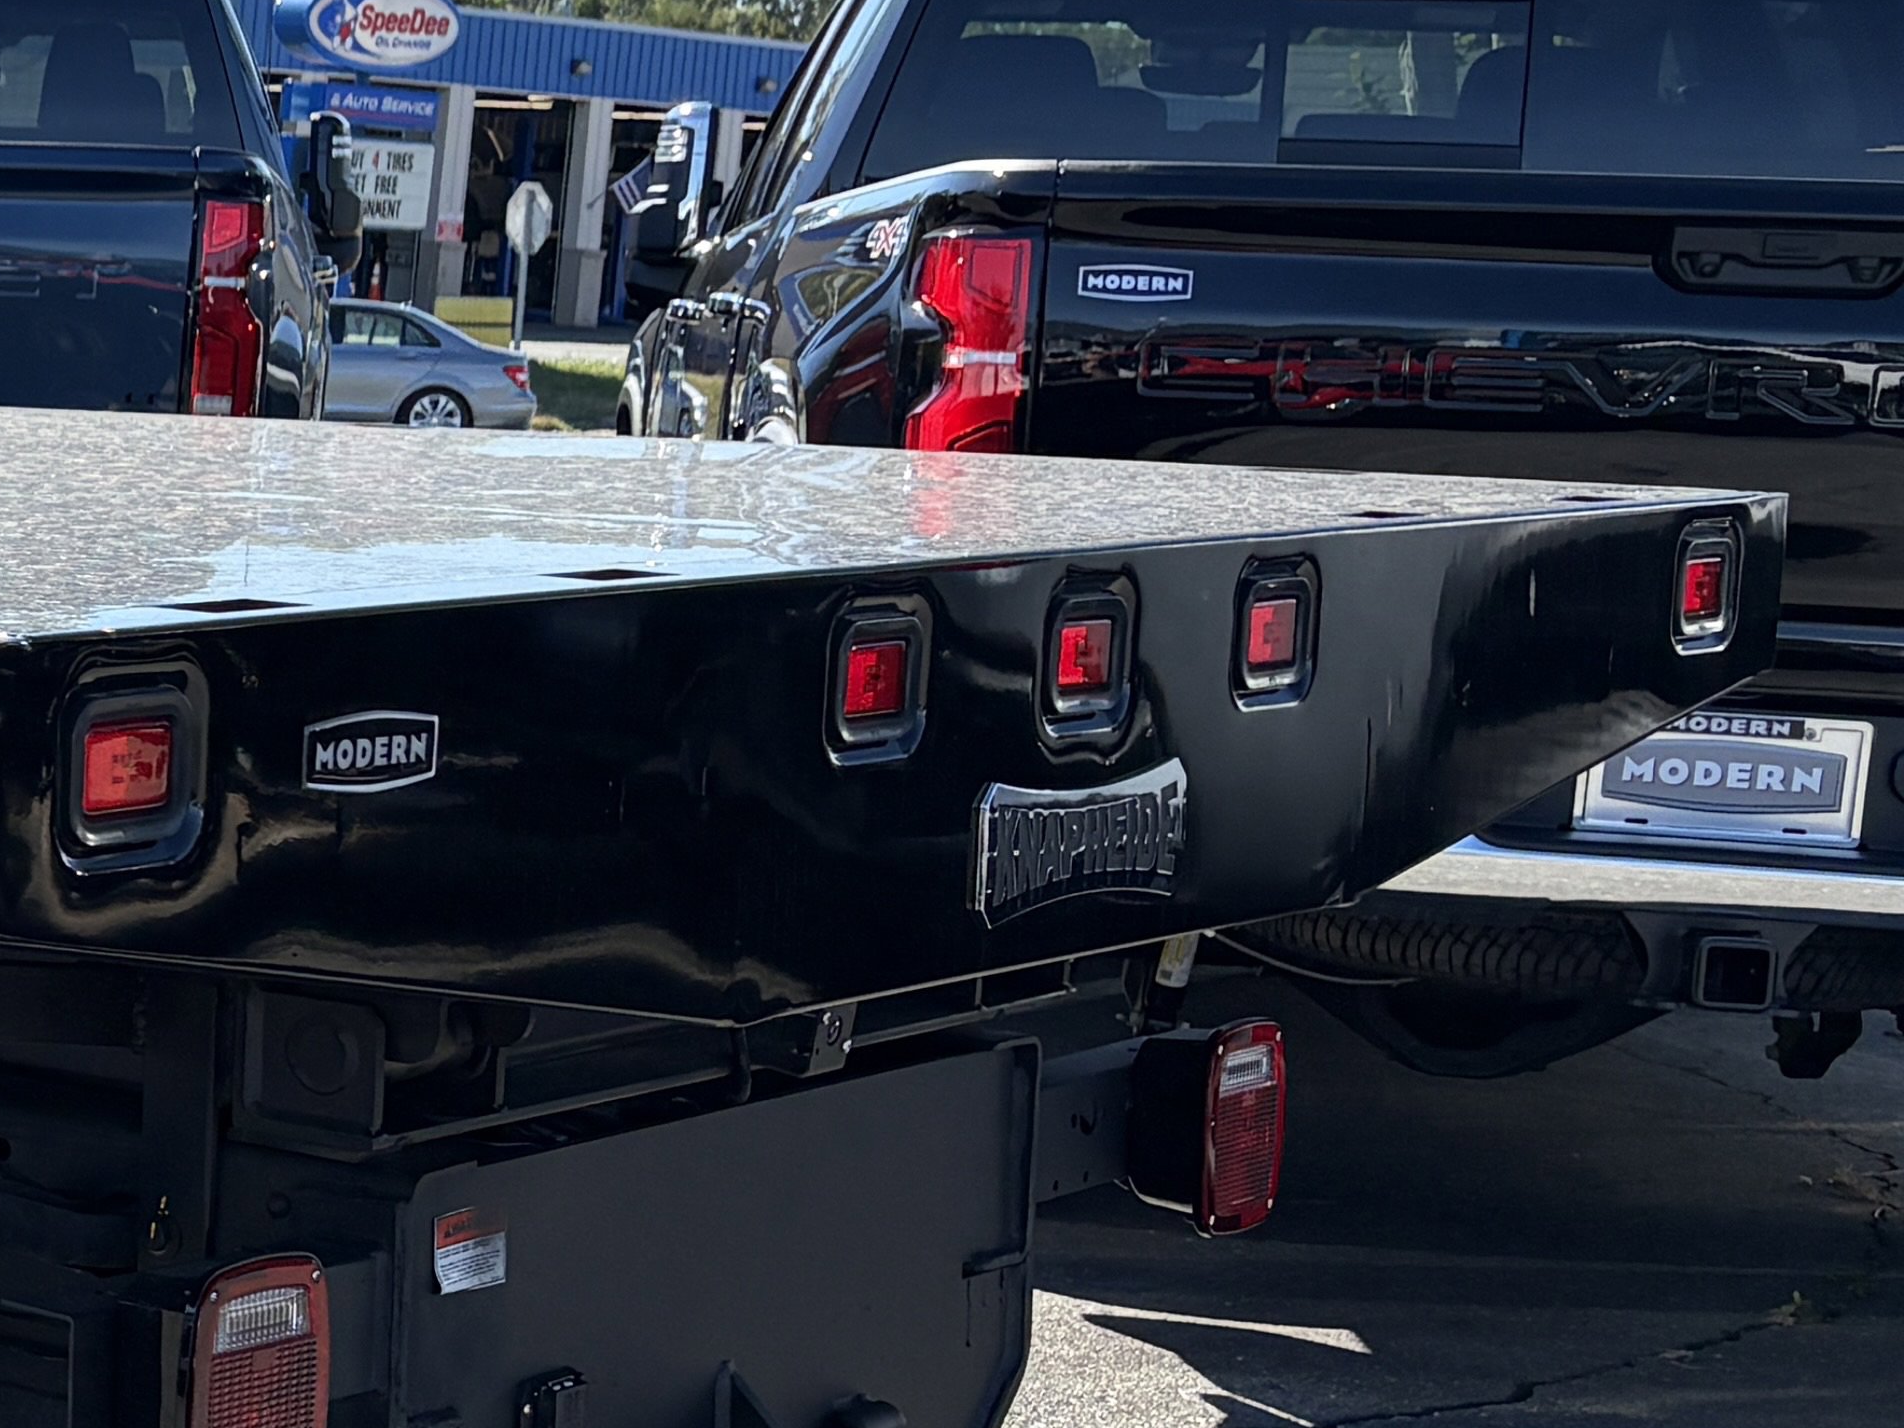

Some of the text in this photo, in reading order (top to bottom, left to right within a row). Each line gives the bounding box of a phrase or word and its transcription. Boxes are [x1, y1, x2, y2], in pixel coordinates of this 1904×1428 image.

[359, 4, 450, 38] SpeeDee
[342, 92, 379, 111] AUTO
[381, 96, 435, 117] SERVICE
[372, 151, 380, 170] 4
[386, 151, 415, 172] TIRES
[374, 174, 398, 195] FREE
[1086, 272, 1185, 293] MODERN
[1136, 340, 1904, 428] CHEVR
[315, 732, 428, 771] MODERN
[1620, 754, 1824, 795] MODERN
[991, 780, 1180, 908] KNAPHEIDE
